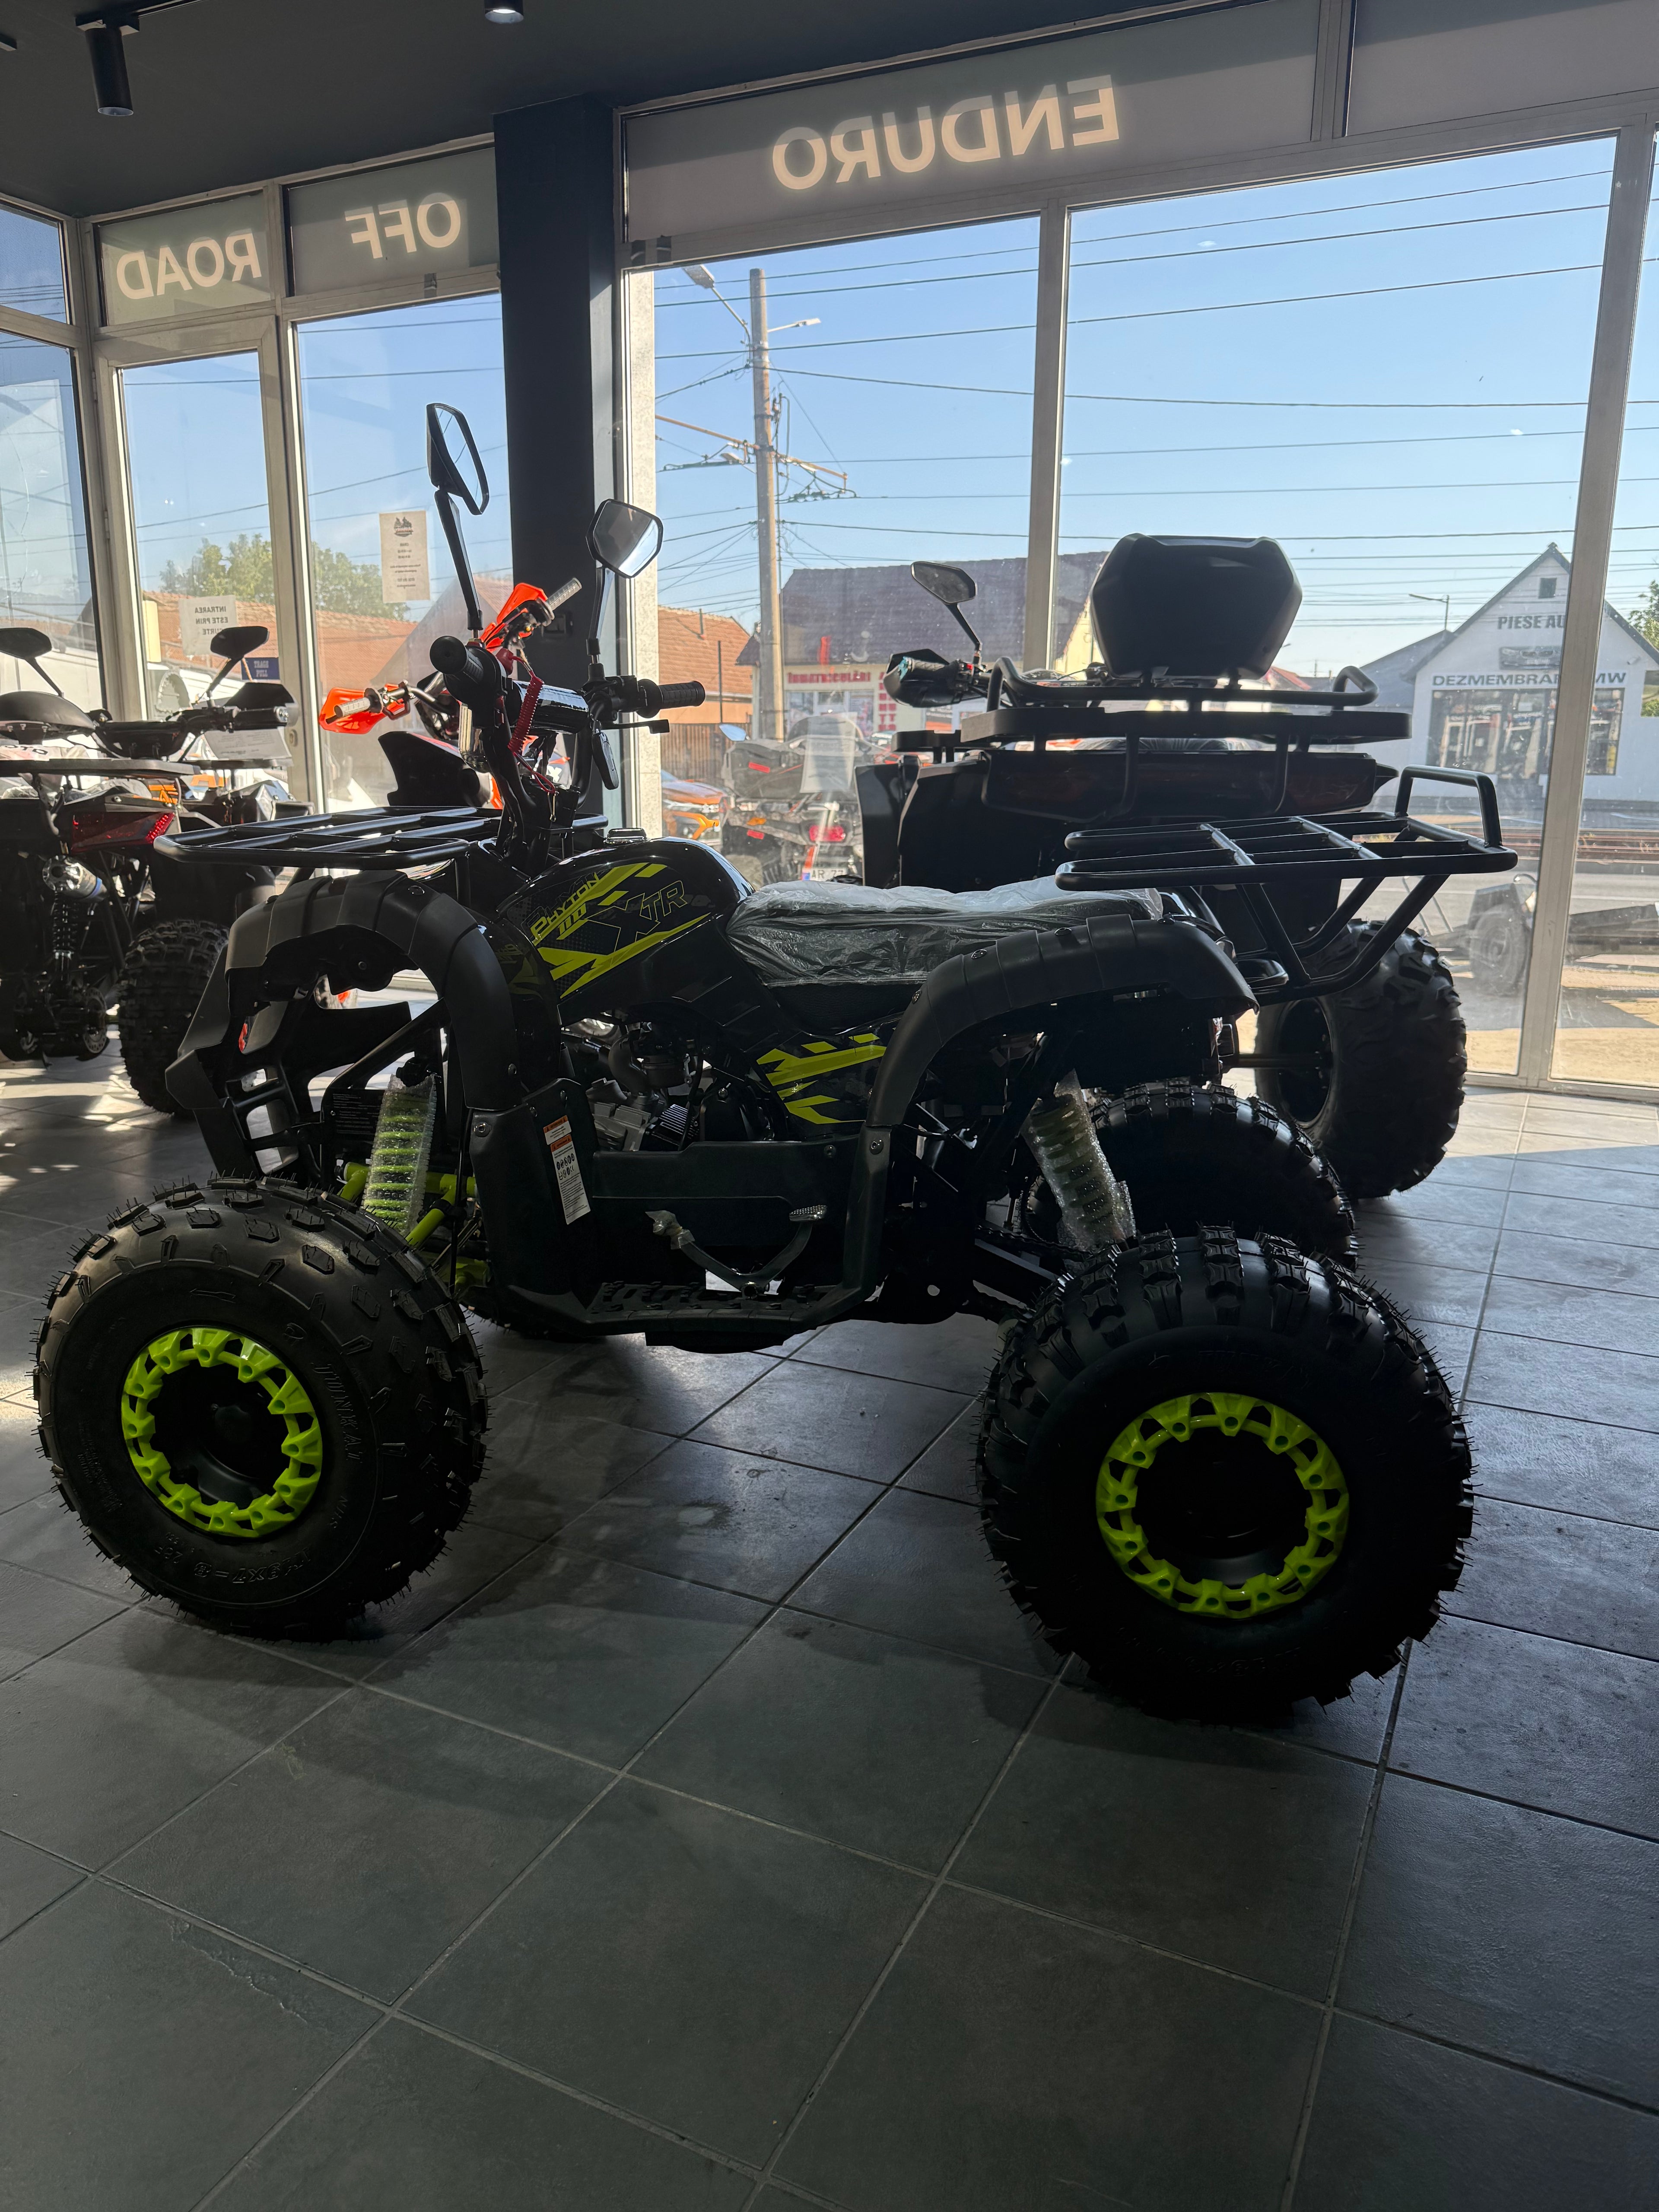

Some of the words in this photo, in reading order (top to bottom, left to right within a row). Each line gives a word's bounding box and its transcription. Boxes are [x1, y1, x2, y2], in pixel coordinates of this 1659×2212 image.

[1497, 616, 1541, 629] PIESE
[1546, 615, 1565, 629] AU
[1595, 673, 1626, 683] MW
[811, 870, 825, 879] AR
[531, 872, 600, 939] PHYTON
[584, 880, 688, 952] XTR
[558, 903, 587, 935] 110
